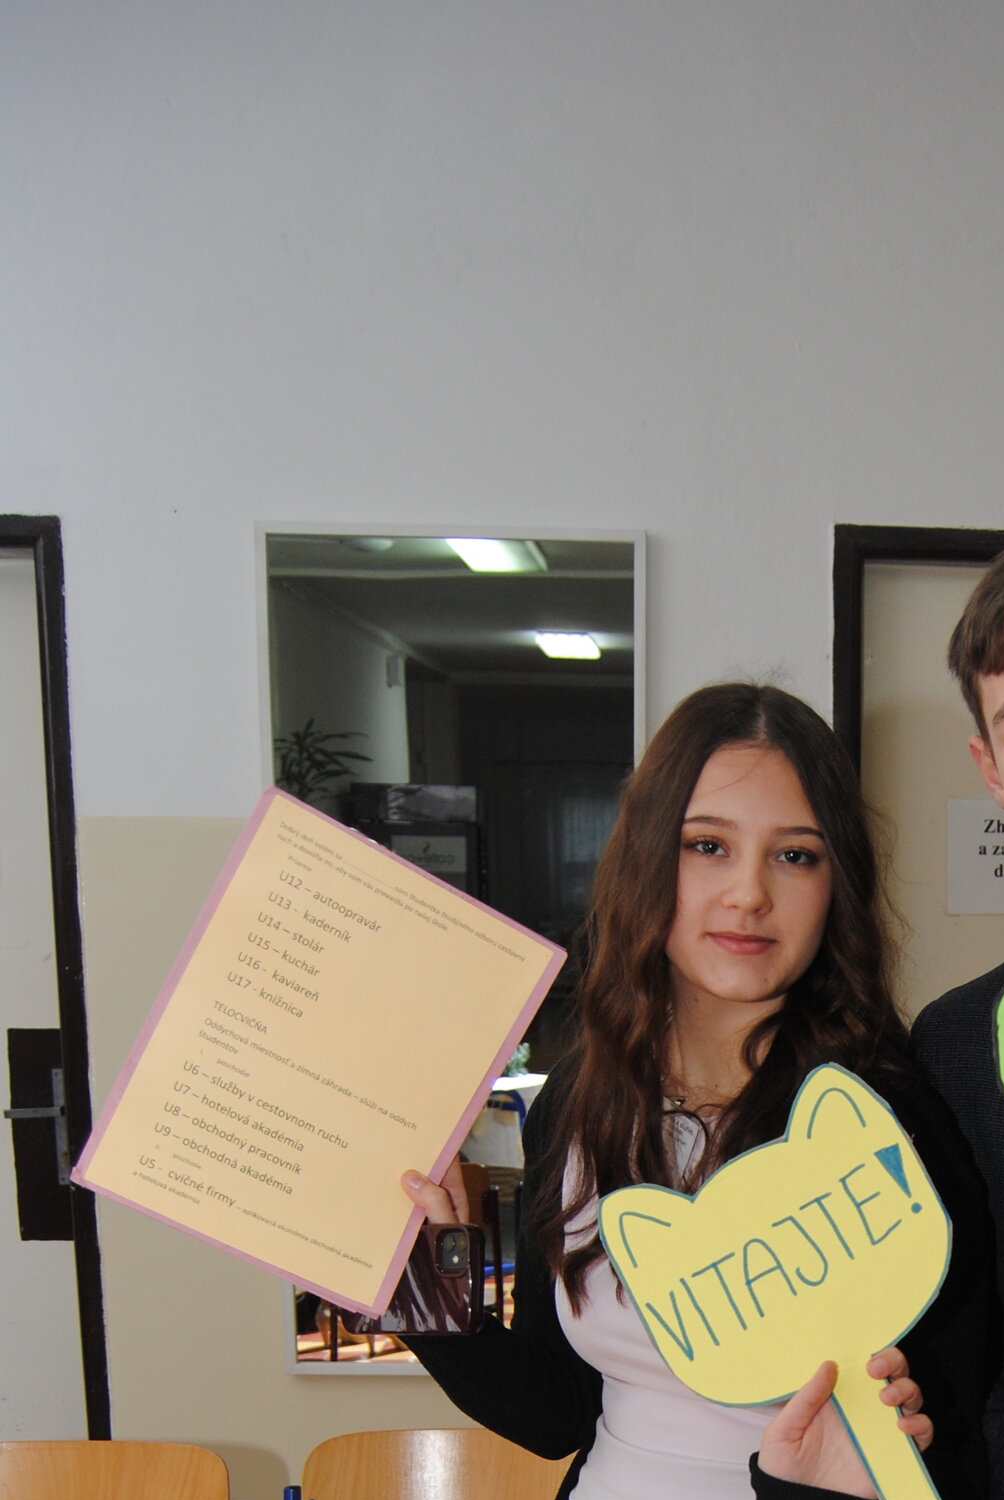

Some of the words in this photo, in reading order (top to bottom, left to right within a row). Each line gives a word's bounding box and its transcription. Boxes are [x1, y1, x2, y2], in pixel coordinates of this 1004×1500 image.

[979, 845, 987, 855] a
[269, 892, 293, 911] U13
[303, 910, 351, 943] kaderník
[280, 871, 303, 890] U12
[313, 892, 382, 933] autoopravár
[248, 932, 271, 951] U15
[282, 951, 321, 977] kuchár
[258, 912, 281, 931] U14
[292, 933, 325, 954] stolár
[228, 972, 252, 989] U17
[259, 988, 304, 1018] knižnica
[238, 952, 261, 970] U16
[272, 970, 320, 1002] kaviareň
[199, 1030, 239, 1055] študentov
[215, 1000, 267, 1035] TELOCVIČŇA
[205, 1018, 249, 1045] Oddychová
[250, 1042, 291, 1066] miestnosť
[297, 1066, 321, 1081] zimná
[321, 1079, 352, 1097] záhrada
[378, 1107, 388, 1116] na
[389, 1113, 417, 1131] oddych
[174, 1081, 192, 1095] U7
[202, 1095, 250, 1126] hotelová
[252, 1122, 304, 1152] akadémia
[184, 1061, 200, 1076] U6
[211, 1077, 247, 1100] služby
[248, 1094, 255, 1103] v
[256, 1099, 316, 1133] cestovnom
[317, 1130, 349, 1149] ruchu
[155, 1123, 172, 1137] U9
[183, 1138, 238, 1169] obchodná
[240, 1165, 293, 1195] akadémia
[164, 1102, 181, 1117] U8
[192, 1118, 248, 1150] obchodný
[248, 1145, 302, 1175] pracovník
[140, 1155, 157, 1169] U5
[168, 1171, 204, 1192] cvičné
[206, 1186, 237, 1208] firmy
[646, 1142, 922, 1361] VITAJTE!
